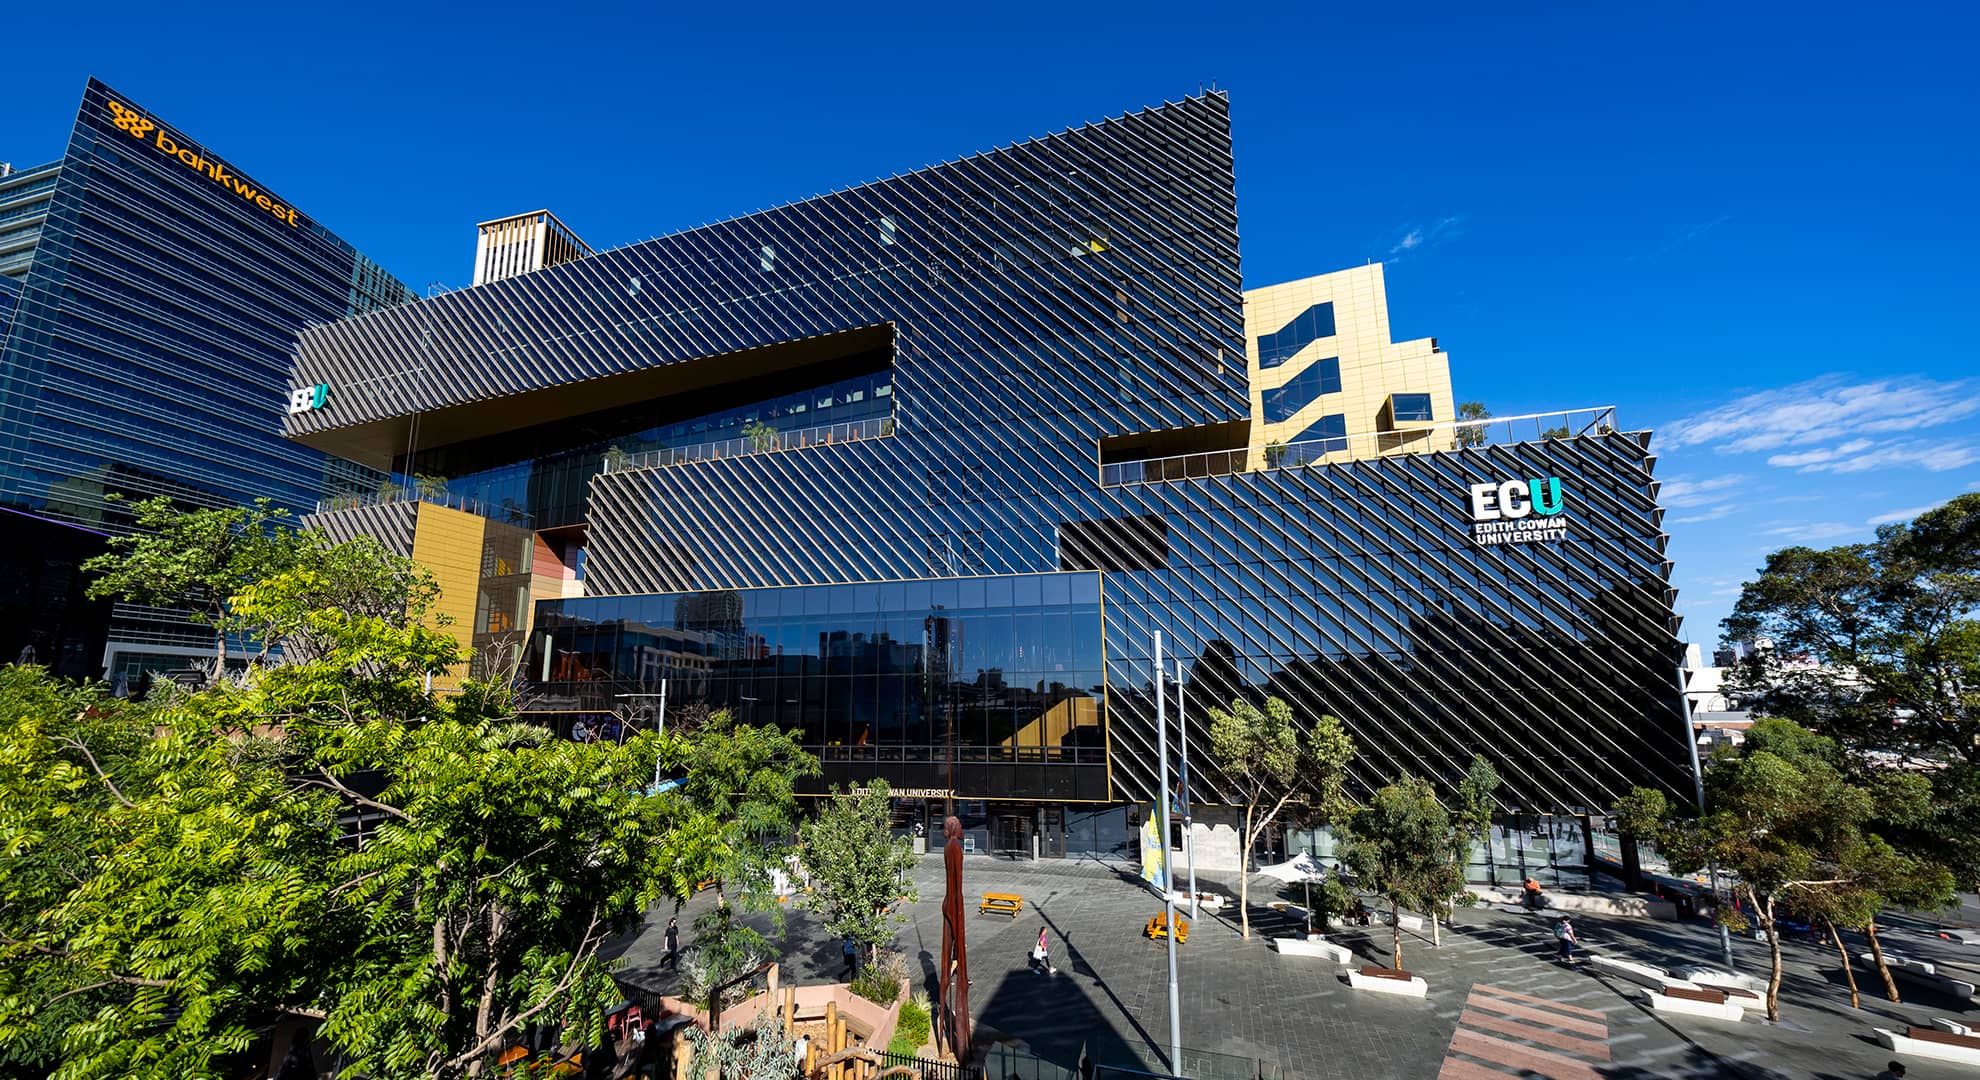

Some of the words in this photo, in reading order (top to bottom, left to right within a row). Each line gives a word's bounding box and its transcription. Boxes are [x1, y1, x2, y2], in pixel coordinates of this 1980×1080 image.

[155, 129, 299, 229] bankwest
[290, 383, 329, 414] ECU
[1470, 476, 1564, 521] ECU
[1475, 521, 1515, 534] EDITH
[1517, 517, 1567, 531] COWAN
[1476, 528, 1567, 545] UNIVERSITY
[906, 788, 956, 799] UNIVERSITY
